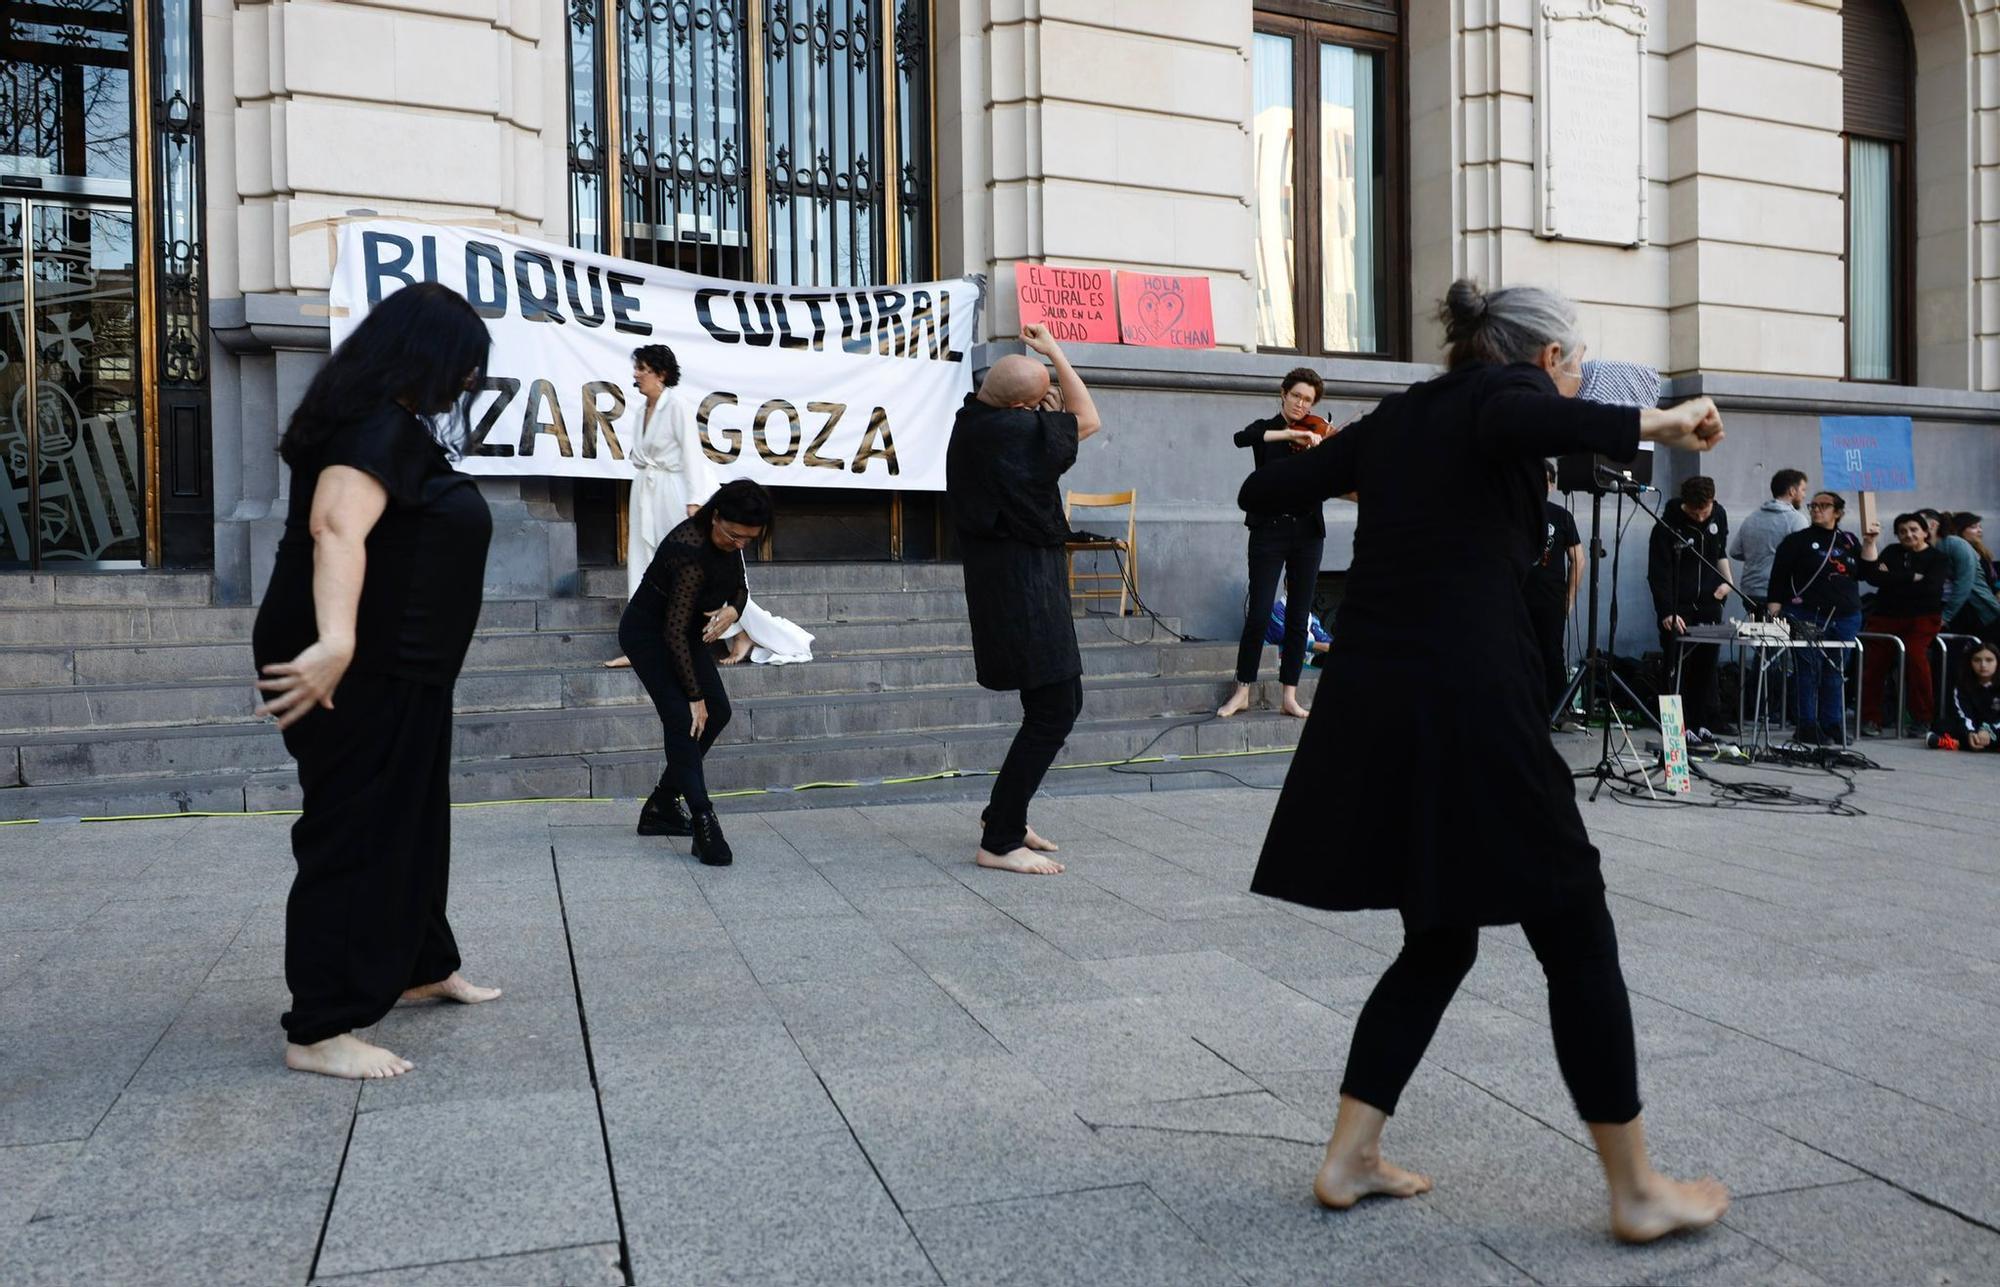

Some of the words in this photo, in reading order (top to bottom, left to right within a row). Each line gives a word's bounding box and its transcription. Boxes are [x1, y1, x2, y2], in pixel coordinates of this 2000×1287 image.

[1029, 267, 1046, 286] EL
[1051, 269, 1102, 290] TEJIDO
[1020, 285, 1086, 306] CULTURAL
[1090, 292, 1105, 307] ES
[1041, 304, 1067, 319] SALUD
[1071, 309, 1084, 320] EN
[1087, 310, 1103, 321] LA
[694, 288, 963, 362] CULTURAL
[1039, 320, 1088, 341] IUDAD
[1123, 325, 1147, 343] NOS
[1169, 329, 1210, 345] ECHAN
[470, 377, 899, 476] ZARGOZA
